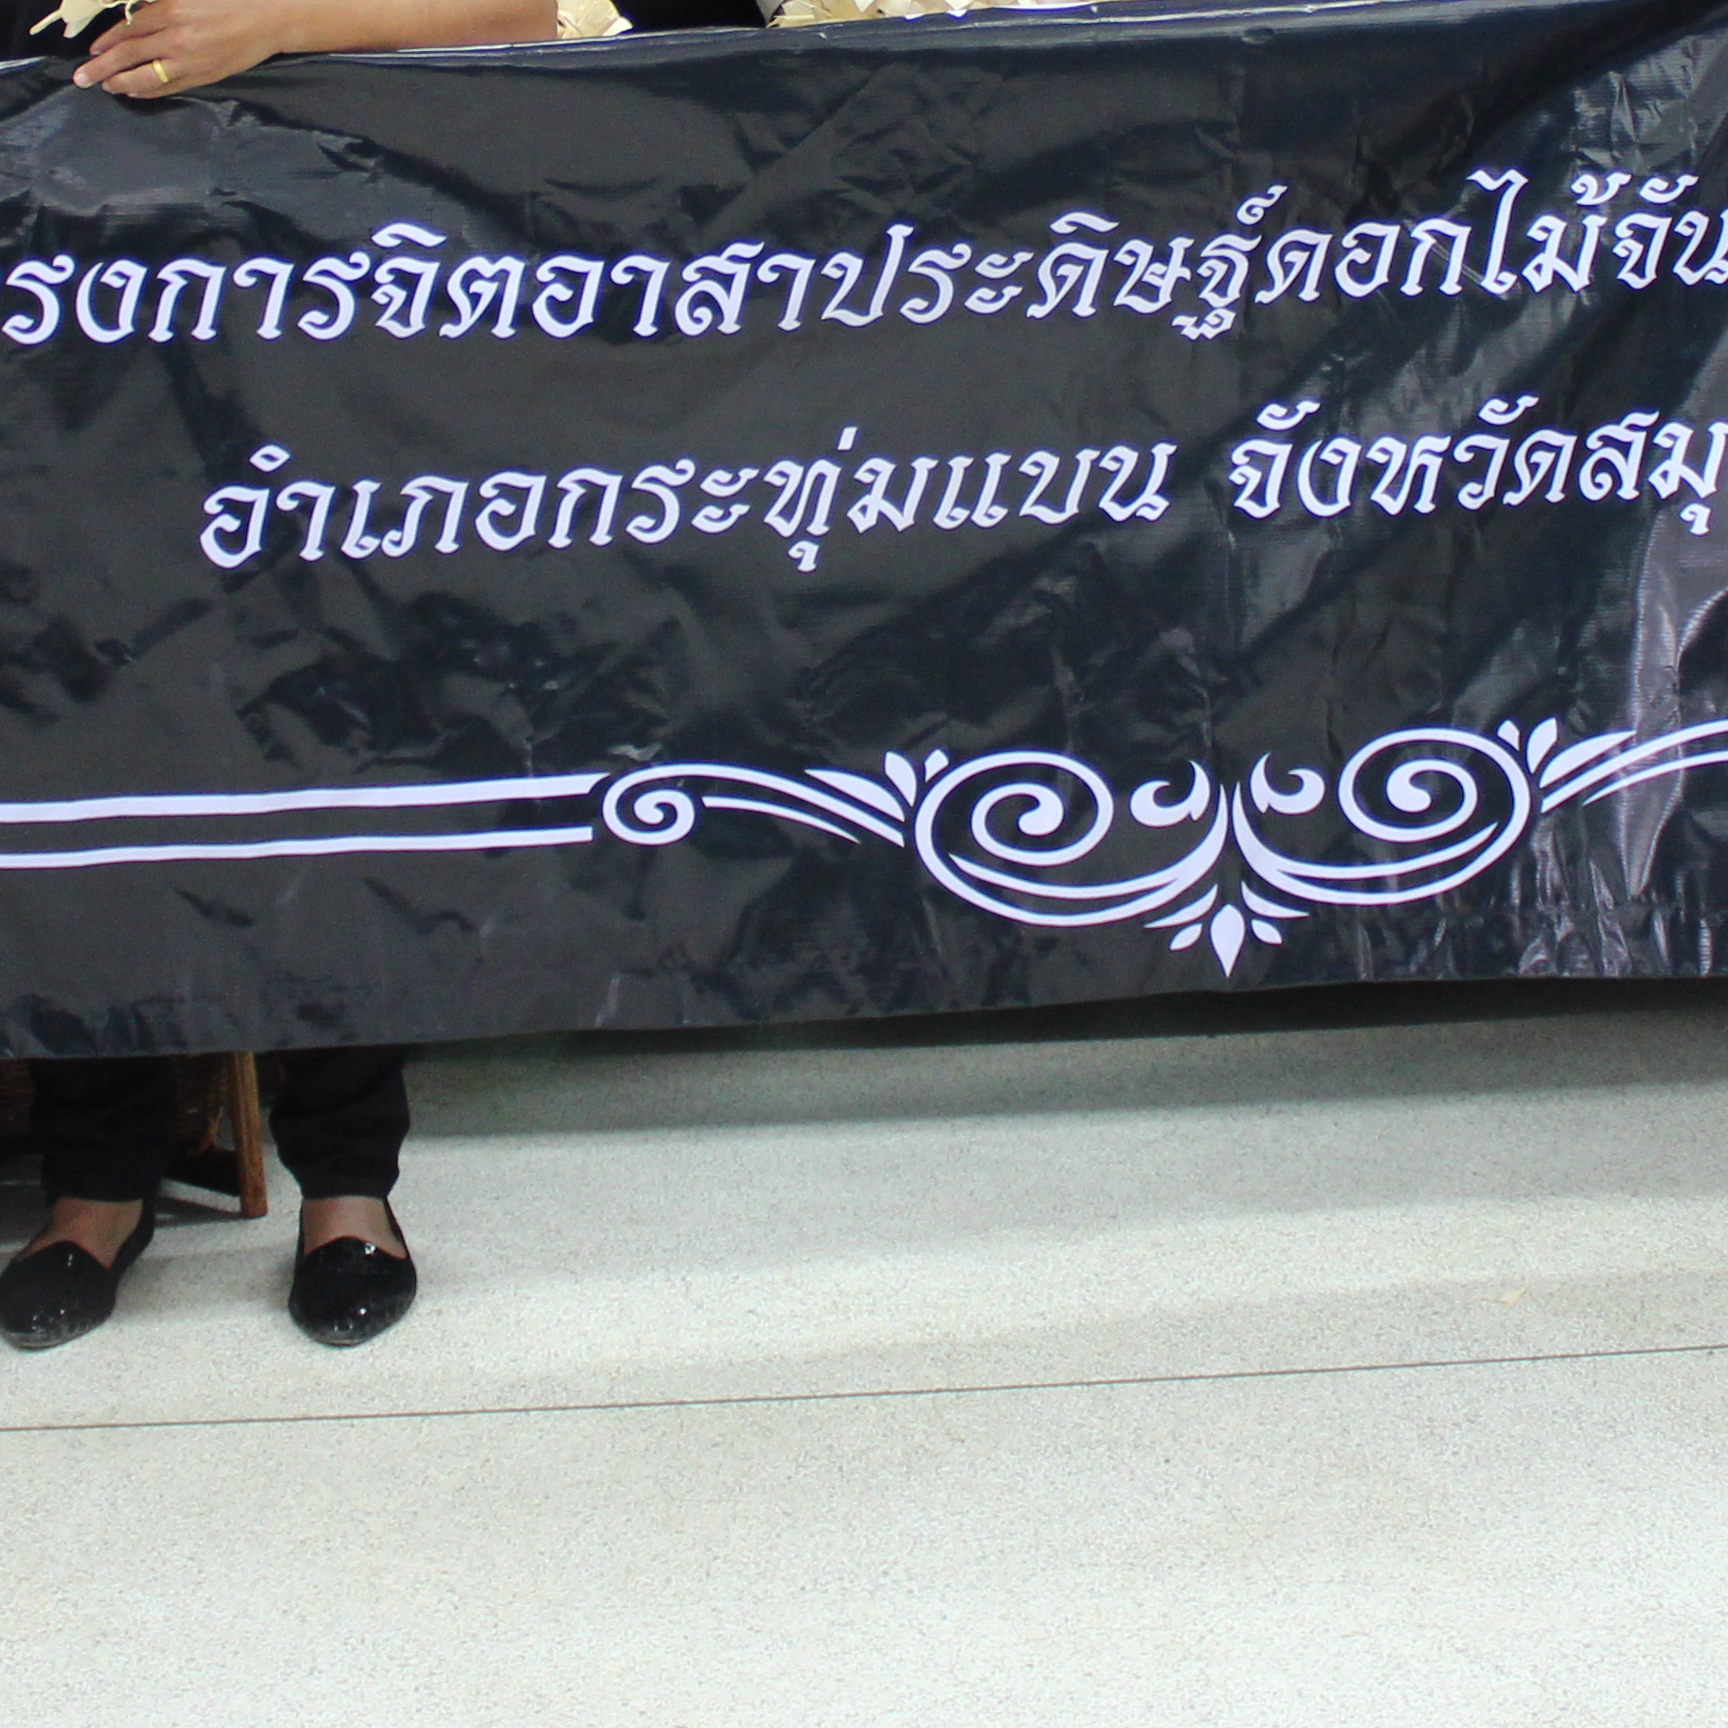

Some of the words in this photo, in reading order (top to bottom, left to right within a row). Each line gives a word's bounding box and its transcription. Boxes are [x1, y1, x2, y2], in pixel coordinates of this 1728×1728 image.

[200, 426, 1177, 572] อำเภอกระทุ่มแบน
